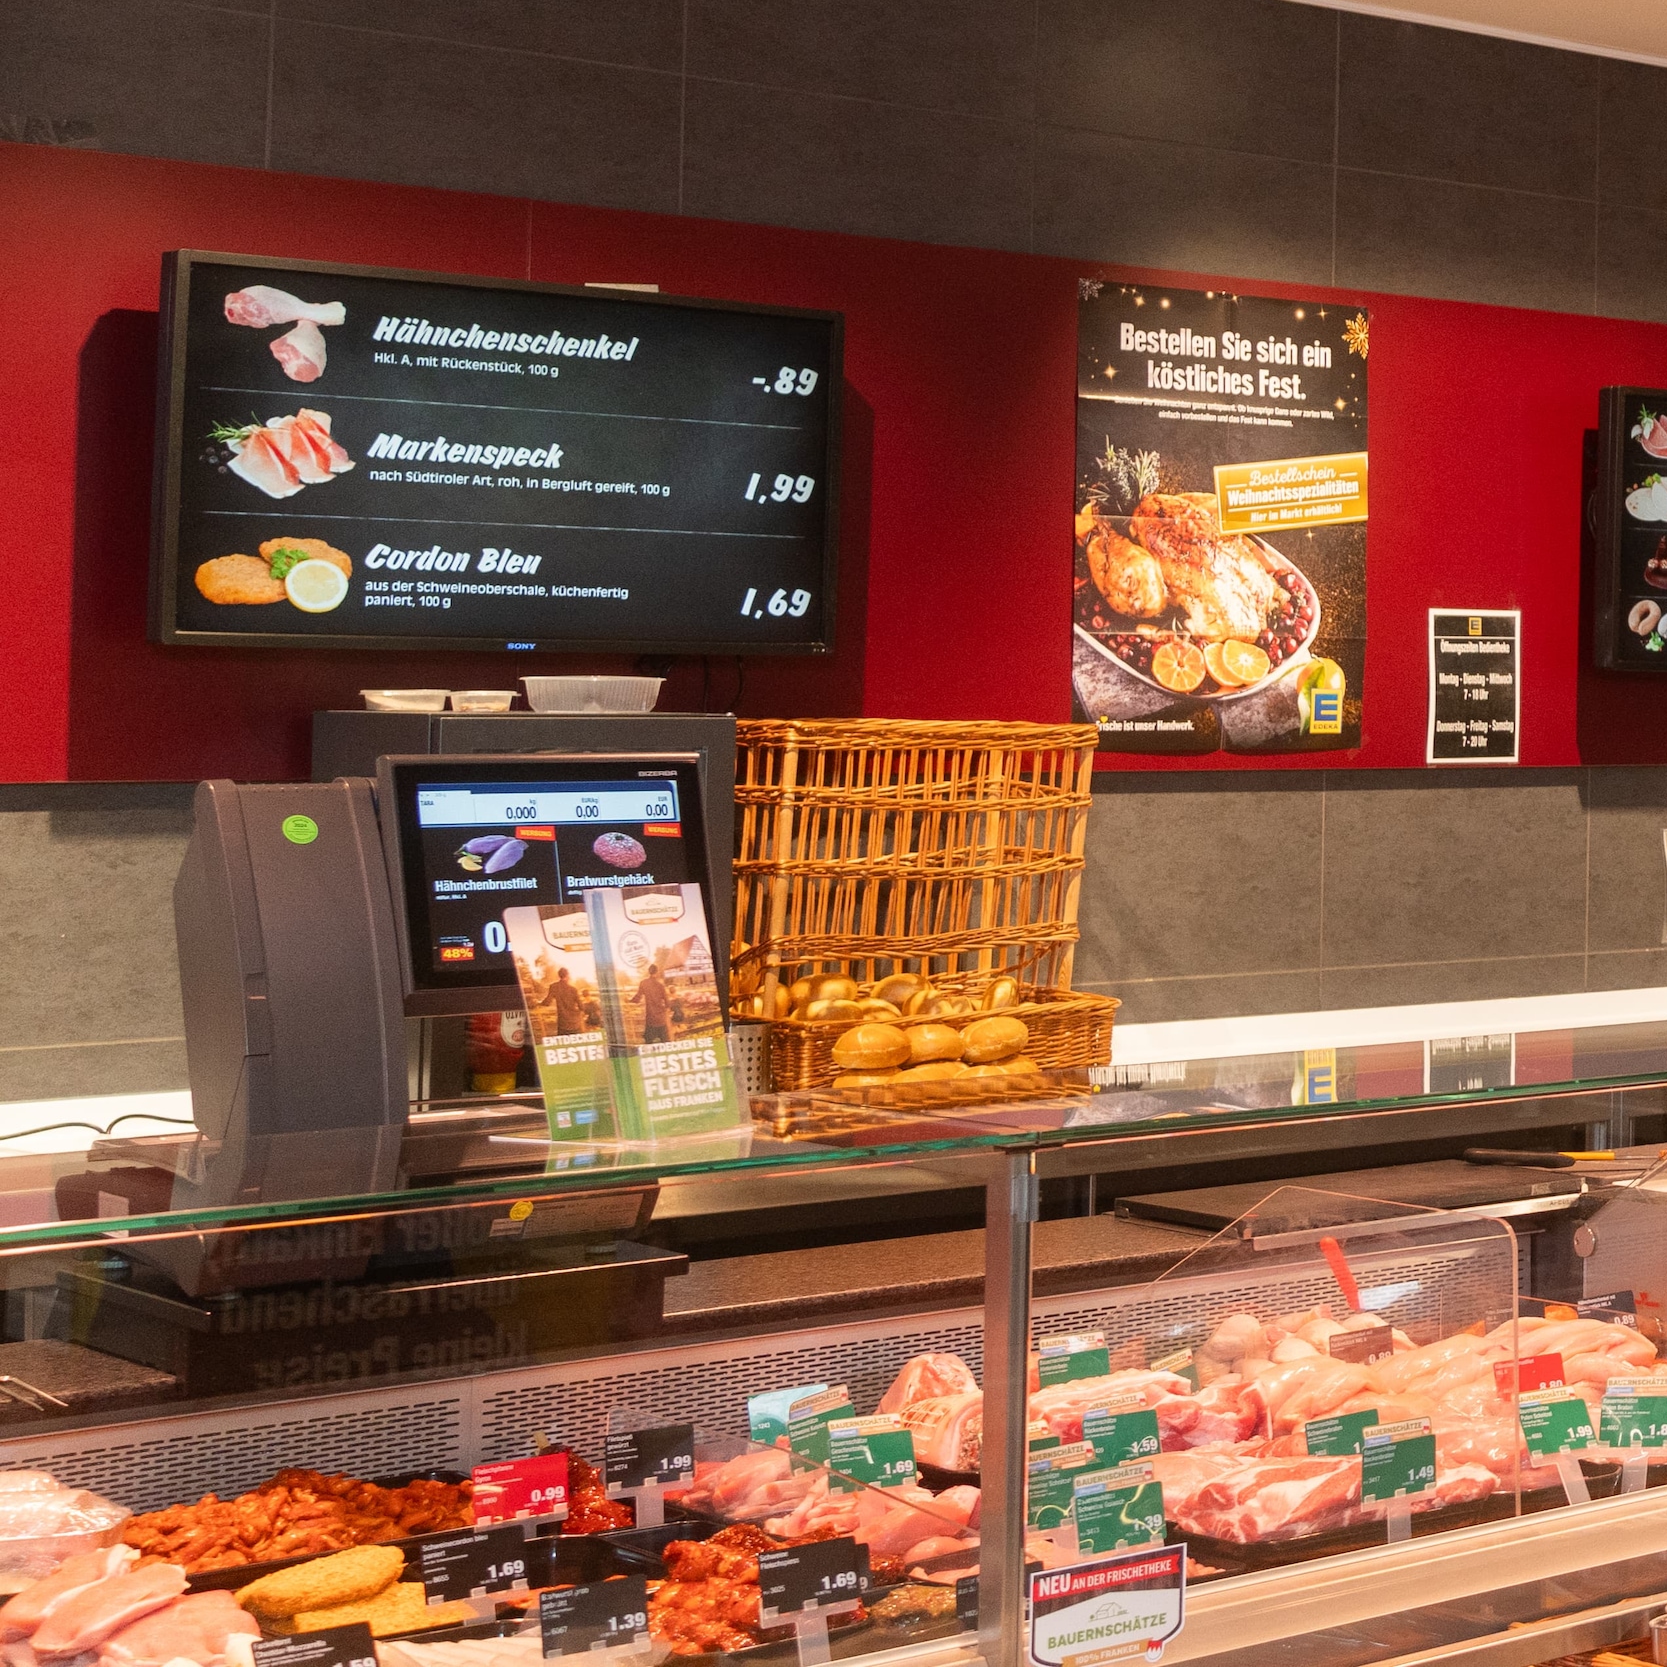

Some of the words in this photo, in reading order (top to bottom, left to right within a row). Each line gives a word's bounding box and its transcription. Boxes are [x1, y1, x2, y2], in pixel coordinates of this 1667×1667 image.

[373, 316, 639, 361] Hähnchenschenkel
[1120, 322, 1216, 358] Bestellen
[1222, 332, 1251, 361] Sie
[1256, 336, 1297, 365] sich
[1303, 340, 1331, 368] ein
[374, 352, 397, 365] Hkl.
[401, 355, 413, 367] A,
[416, 356, 438, 368] mit
[442, 357, 525, 375] Rückenstück,
[528, 364, 548, 376] 100
[550, 367, 559, 377] g
[751, 367, 819, 396] -.89
[1148, 360, 1254, 395] köstliches
[1259, 369, 1306, 400] Fest.
[367, 433, 564, 469] Markenspeck
[370, 469, 402, 482] nach
[406, 471, 469, 485] Südtiroler
[473, 475, 494, 488] Art,
[498, 476, 523, 489] roh,
[526, 477, 538, 488] in
[542, 478, 592, 493] Bergluft
[595, 481, 638, 495] gereift,
[641, 484, 659, 495] 100
[1250, 466, 1336, 485] Bestellschein
[745, 472, 814, 504] 1,99
[1227, 481, 1359, 506] Weihnachtsspezialitäten
[1251, 512, 1266, 523] Hier
[1268, 510, 1278, 520] im
[1280, 508, 1302, 520] Markt
[1304, 503, 1342, 518] erhältlich!
[365, 543, 471, 571] Cordon
[477, 548, 542, 574] Bleu
[365, 582, 389, 591] aus
[392, 581, 414, 592] der
[417, 581, 549, 597] Schweineoberschale,
[552, 585, 628, 599] küchenfertig
[365, 595, 416, 607] paniert,
[419, 597, 439, 607] 100
[741, 587, 811, 617] 1,69
[1441, 639, 1478, 655] Öffnungszeiten
[1439, 673, 1459, 687] Montag
[1463, 673, 1485, 687] Dienstag
[1315, 692, 1338, 721] E
[1470, 720, 1488, 734] Freitag
[1492, 720, 1514, 733] Samstag
[506, 806, 536, 819] 0,000
[576, 805, 599, 818] 0,00
[646, 804, 668, 817] 0,00
[435, 878, 537, 892] Hähnchenbrustfilet
[567, 874, 654, 888] Bratwurstgehäck
[443, 948, 473, 958] 48%
[542, 1032, 603, 1046] ENTDECKEN
[638, 1040, 695, 1055] ENTDECKEN
[698, 1038, 714, 1048] SIE
[545, 1045, 605, 1065] BESTES
[641, 1050, 717, 1078] BESTES
[644, 1071, 721, 1097] FLEISCH
[649, 1099, 673, 1112] AUS
[675, 1090, 723, 1107] FRANKEN
[1365, 1422, 1422, 1437] BAUERNSCHÄTZE
[1567, 1425, 1592, 1439] 1.99
[661, 1455, 691, 1471] 1.99
[884, 1460, 913, 1475] 1.69
[1408, 1465, 1433, 1481] 1.49
[1076, 1466, 1143, 1487] BAUERNSCHÄTZE
[531, 1486, 565, 1503] 0.99
[487, 1560, 525, 1579] 1.69
[1039, 1573, 1071, 1597] NEU
[1072, 1577, 1086, 1590] AN
[1087, 1574, 1105, 1587] DER
[1107, 1560, 1172, 1583] FRISCHETHEKE
[822, 1571, 856, 1590] 1.69
[608, 1612, 646, 1632] 1.39
[1048, 1612, 1167, 1650] BAUERNSCHÄTZE
[1100, 1644, 1140, 1659] FRANKEN
